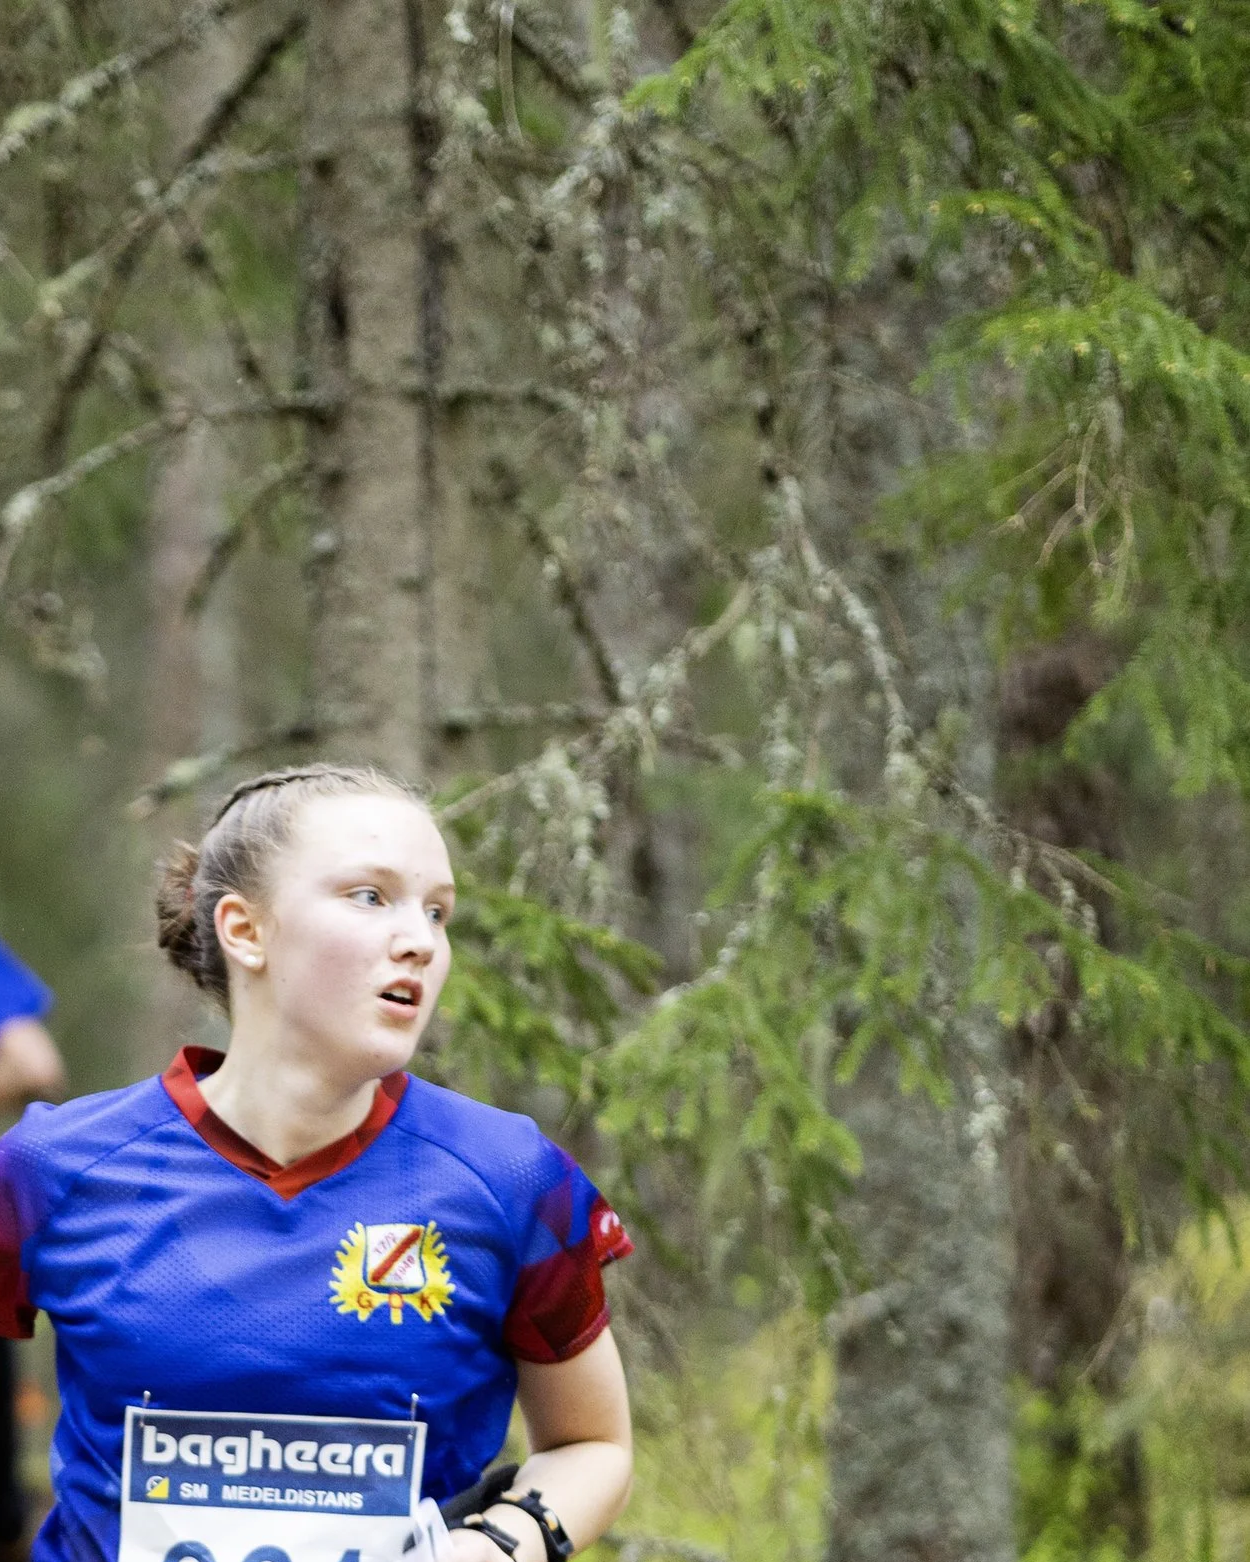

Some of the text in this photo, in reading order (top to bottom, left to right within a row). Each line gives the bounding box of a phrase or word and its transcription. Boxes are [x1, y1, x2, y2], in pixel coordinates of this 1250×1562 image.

[141, 1425, 406, 1477] bagheera
[180, 1482, 364, 1510] SM MEDELDISTANS
